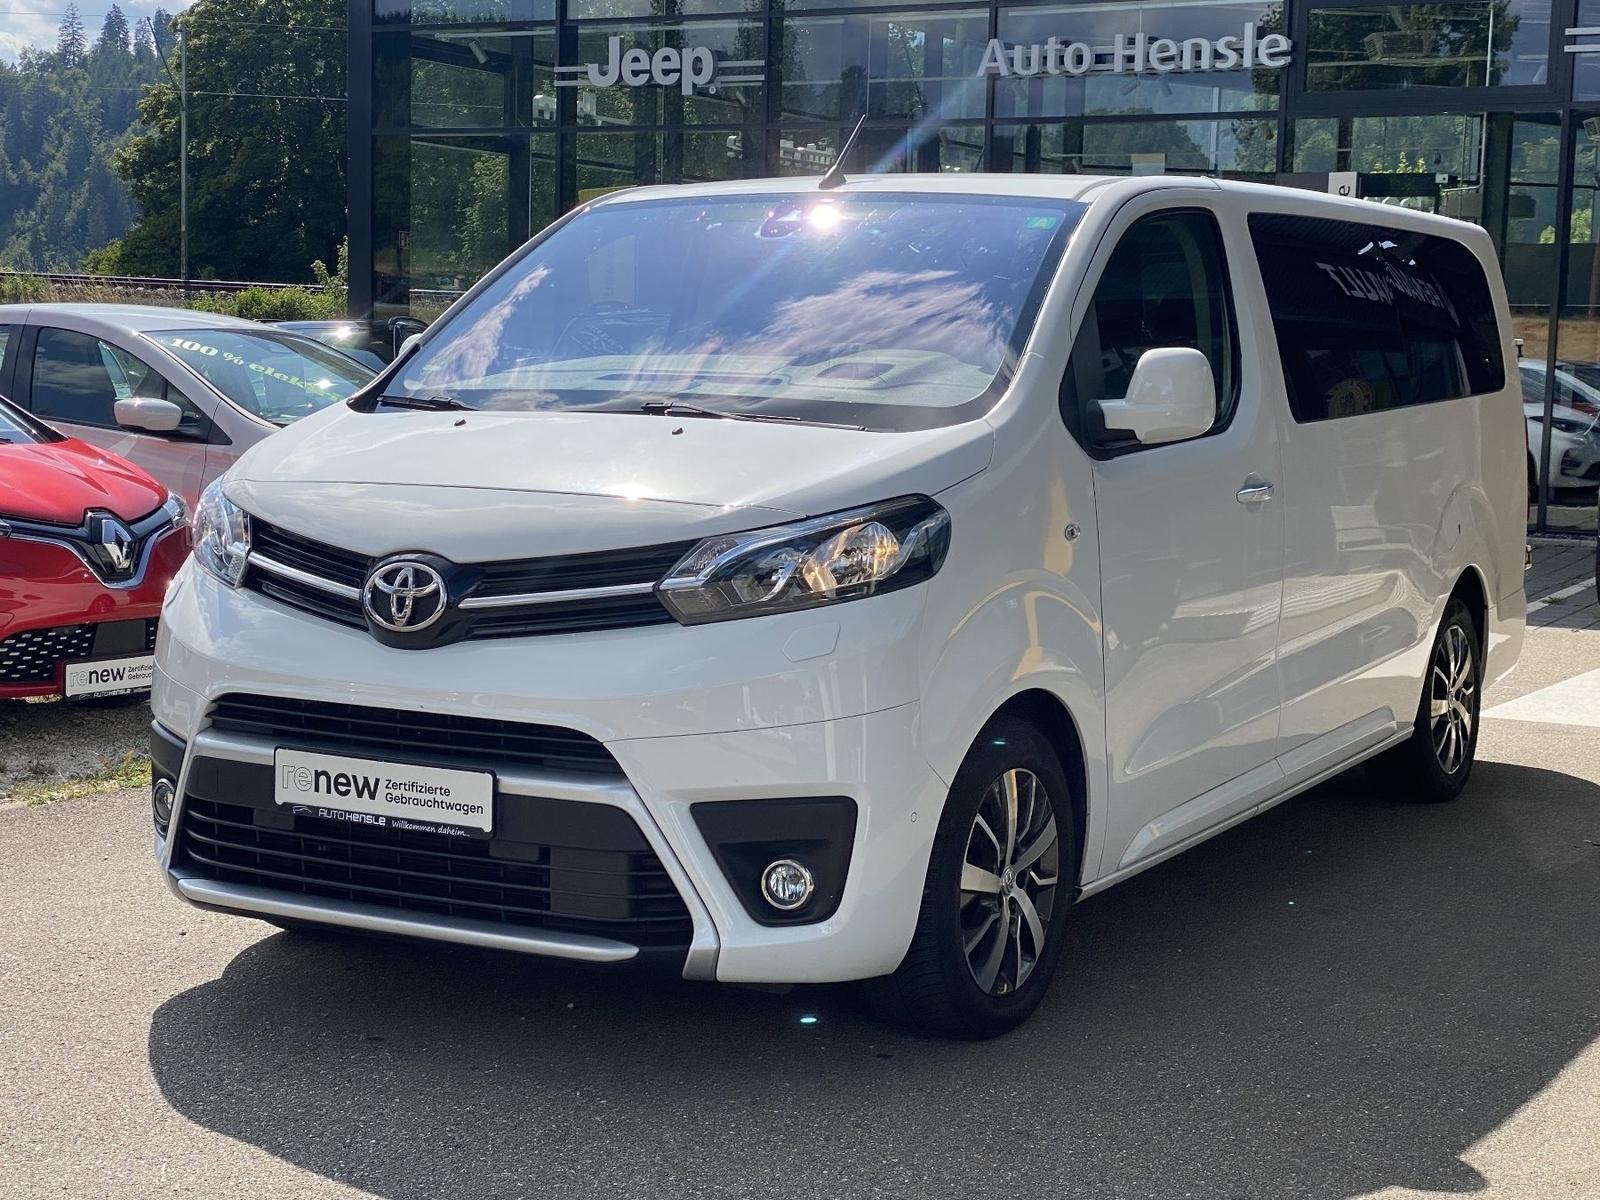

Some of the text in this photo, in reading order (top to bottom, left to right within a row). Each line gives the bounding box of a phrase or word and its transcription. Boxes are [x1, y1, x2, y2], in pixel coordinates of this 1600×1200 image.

[976, 22, 1292, 77] Auto Hensle
[587, 36, 714, 95] Jeep
[170, 337, 219, 356] 100
[222, 351, 244, 366] %
[70, 667, 126, 687] renew
[282, 765, 380, 800] renew
[384, 779, 451, 797] Zertifizierte
[384, 792, 484, 815] Gebrauchtwagen
